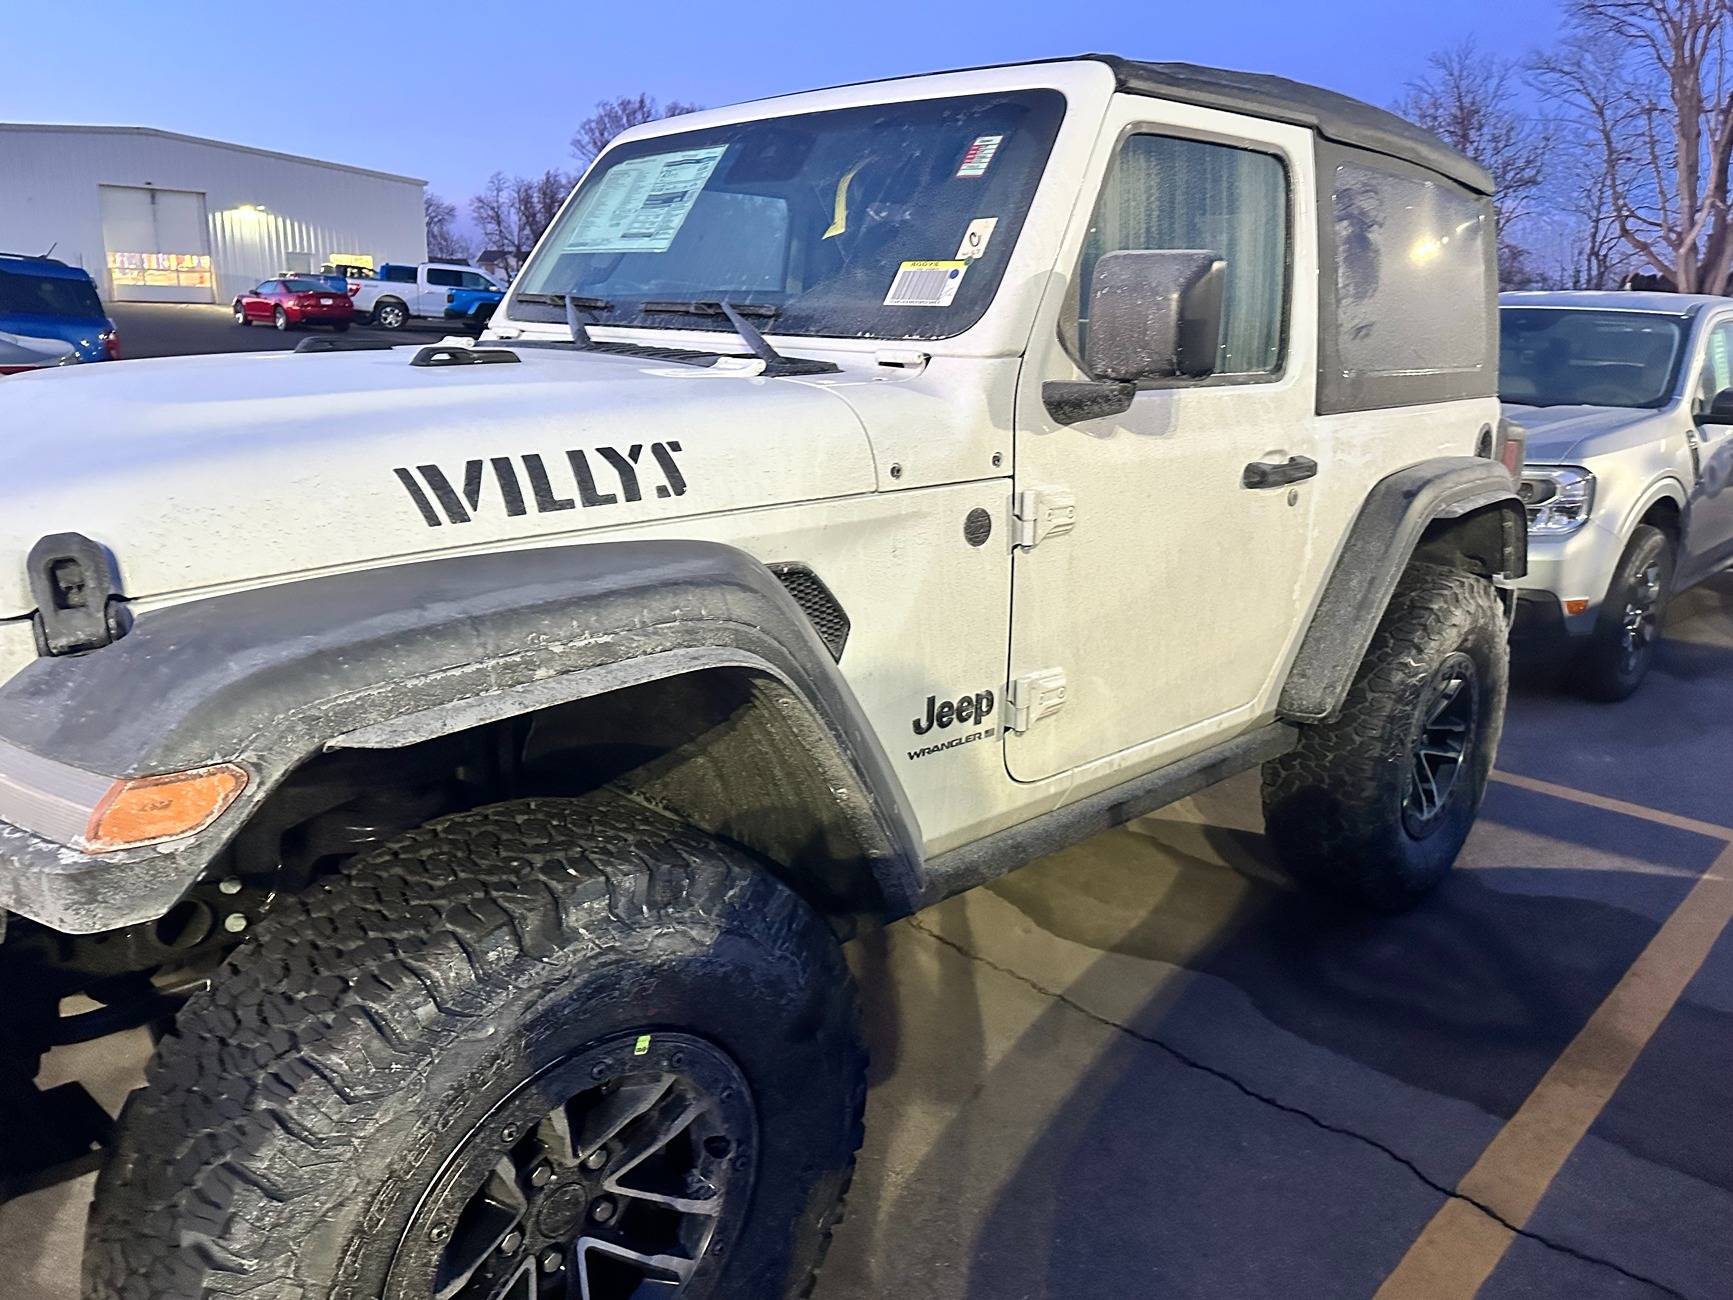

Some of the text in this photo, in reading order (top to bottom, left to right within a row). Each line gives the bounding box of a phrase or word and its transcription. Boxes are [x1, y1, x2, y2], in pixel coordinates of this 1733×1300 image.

[393, 441, 687, 526] WILLYS
[913, 690, 994, 735] Jeep
[908, 732, 982, 760] WRANGLER
